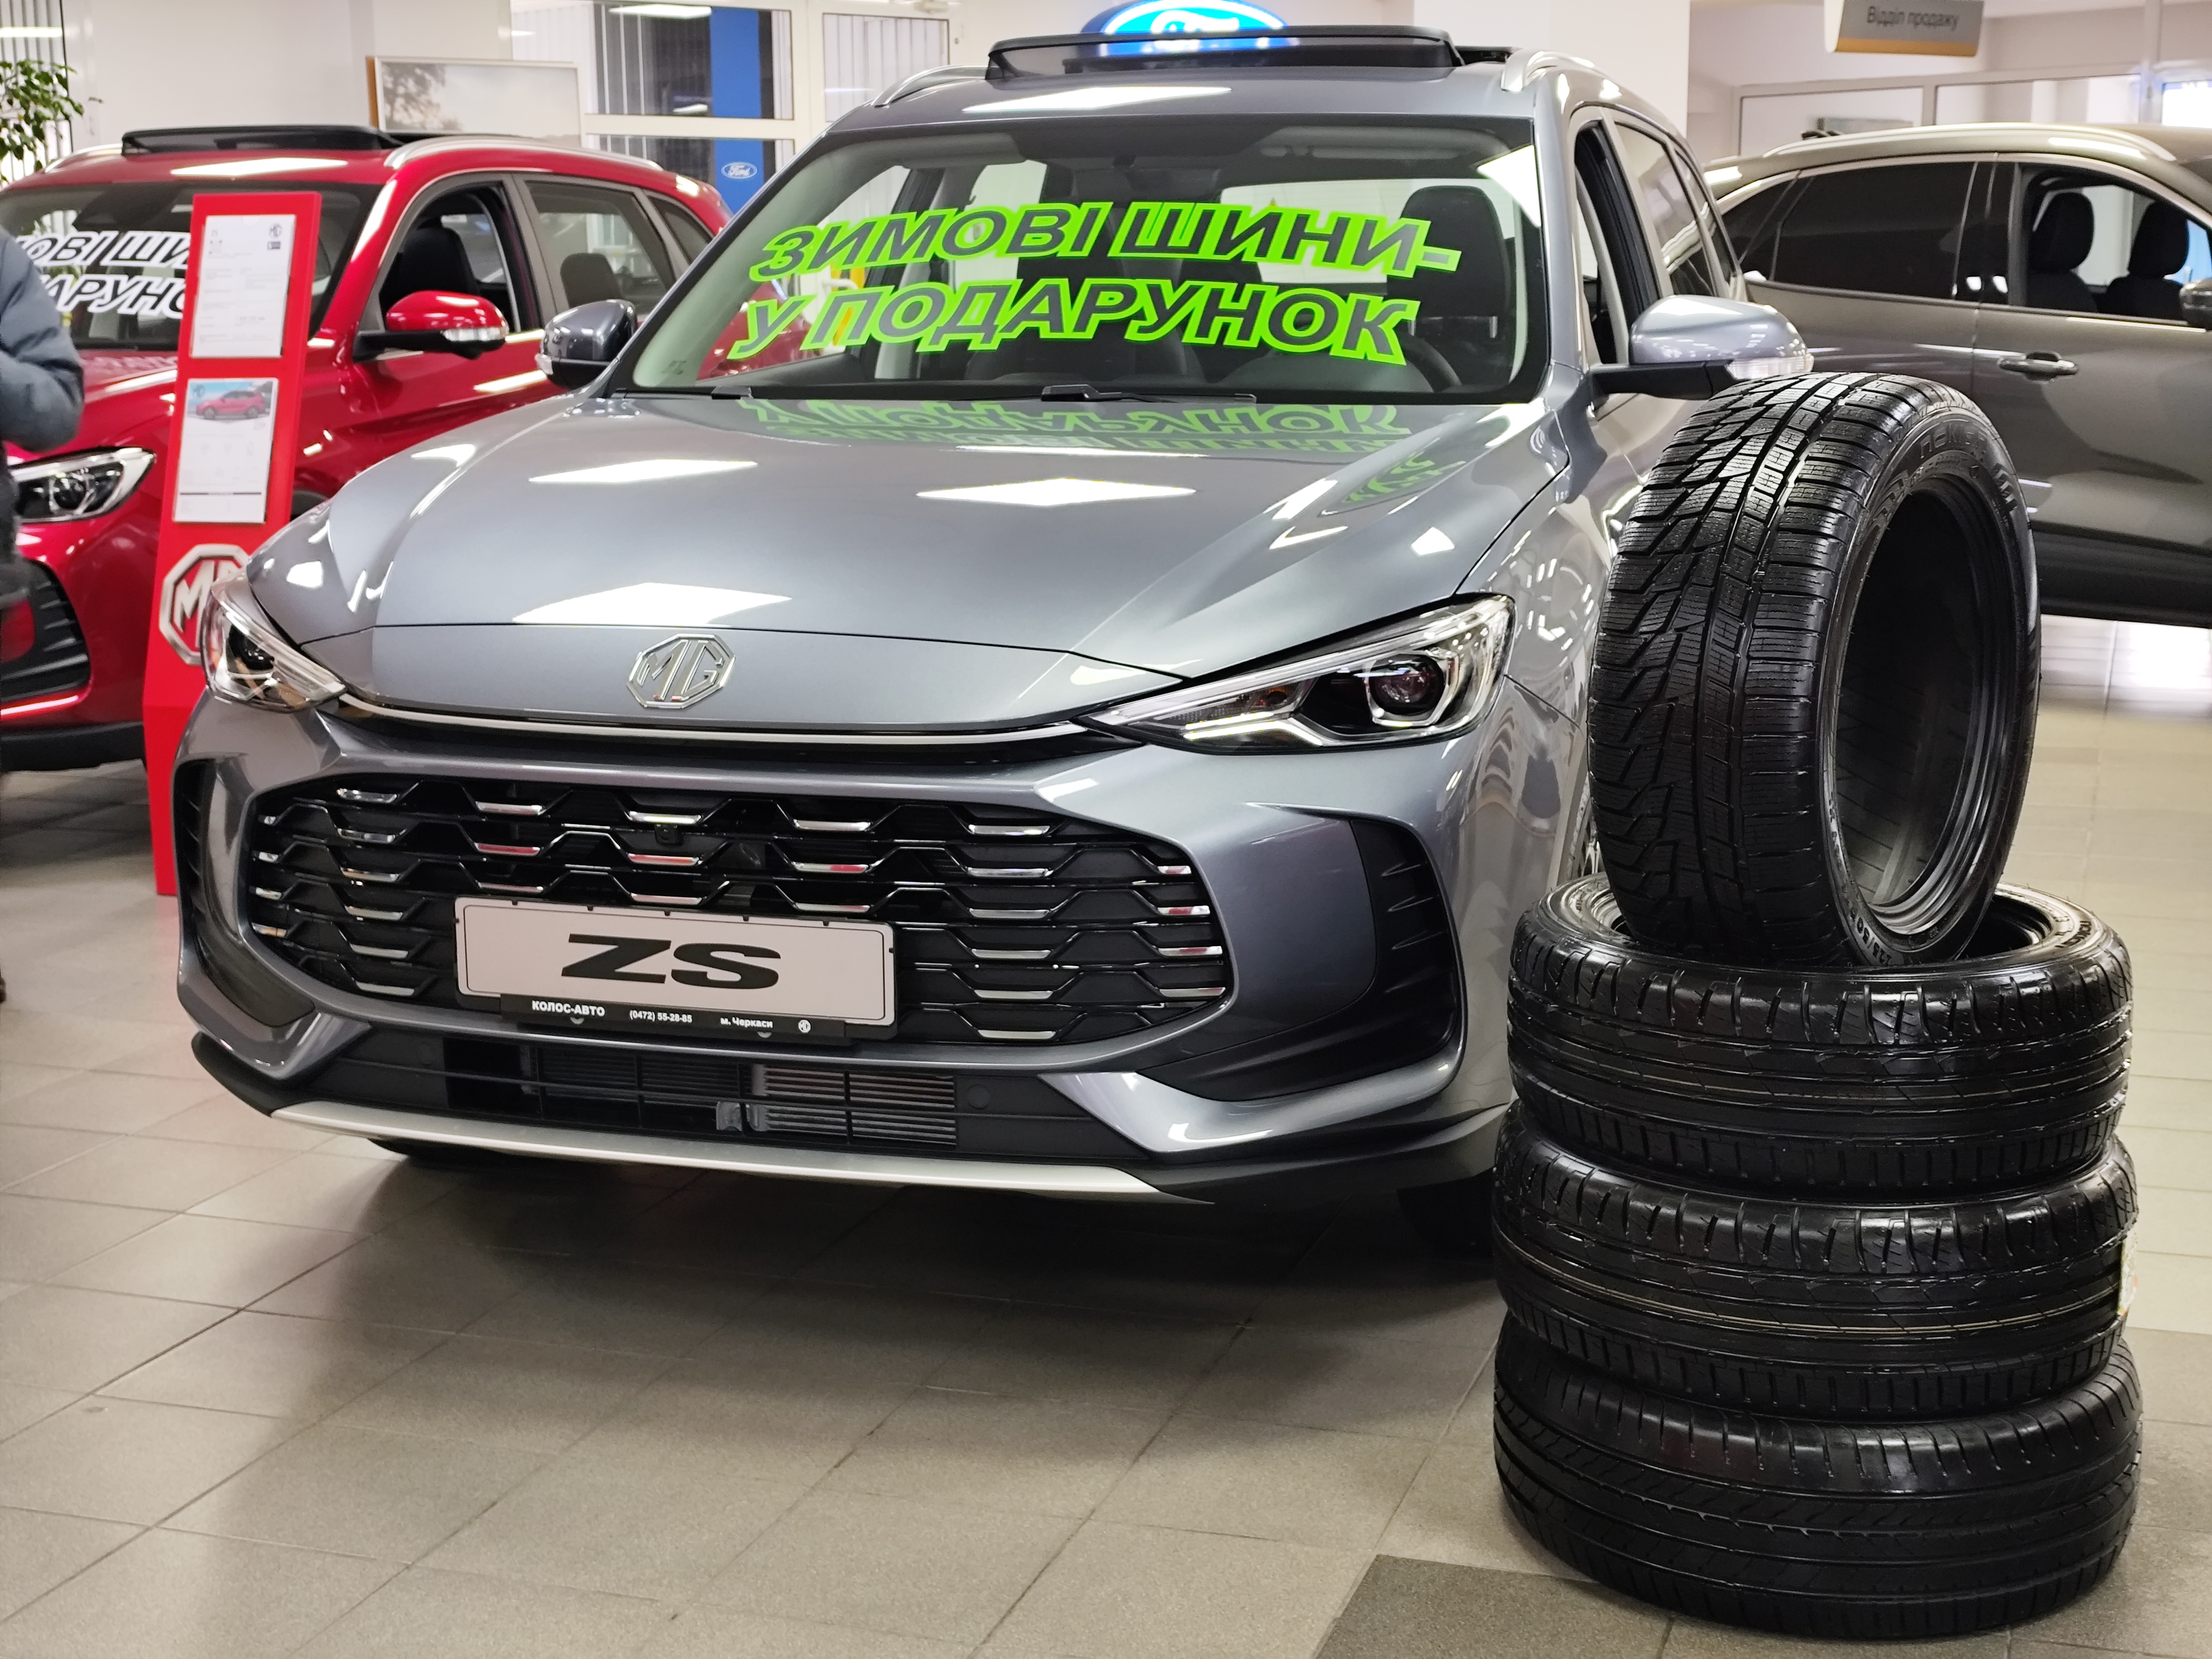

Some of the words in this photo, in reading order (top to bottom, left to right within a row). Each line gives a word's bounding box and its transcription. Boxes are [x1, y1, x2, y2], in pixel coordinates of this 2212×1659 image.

[15, 230, 119, 266] ОВІ
[749, 202, 1113, 282] ЗИМОВІ
[1108, 202, 1461, 279] ШИНИ-
[726, 293, 817, 361] У
[801, 278, 1418, 366] ПОДАРУНОК
[636, 639, 725, 702] MG
[561, 933, 781, 989] ZS
[532, 1000, 605, 1017] КОЛОС-АВТО
[629, 1009, 655, 1022] (0472)
[657, 1012, 692, 1024] 55-28-85
[732, 1017, 773, 1028] Черкаси
